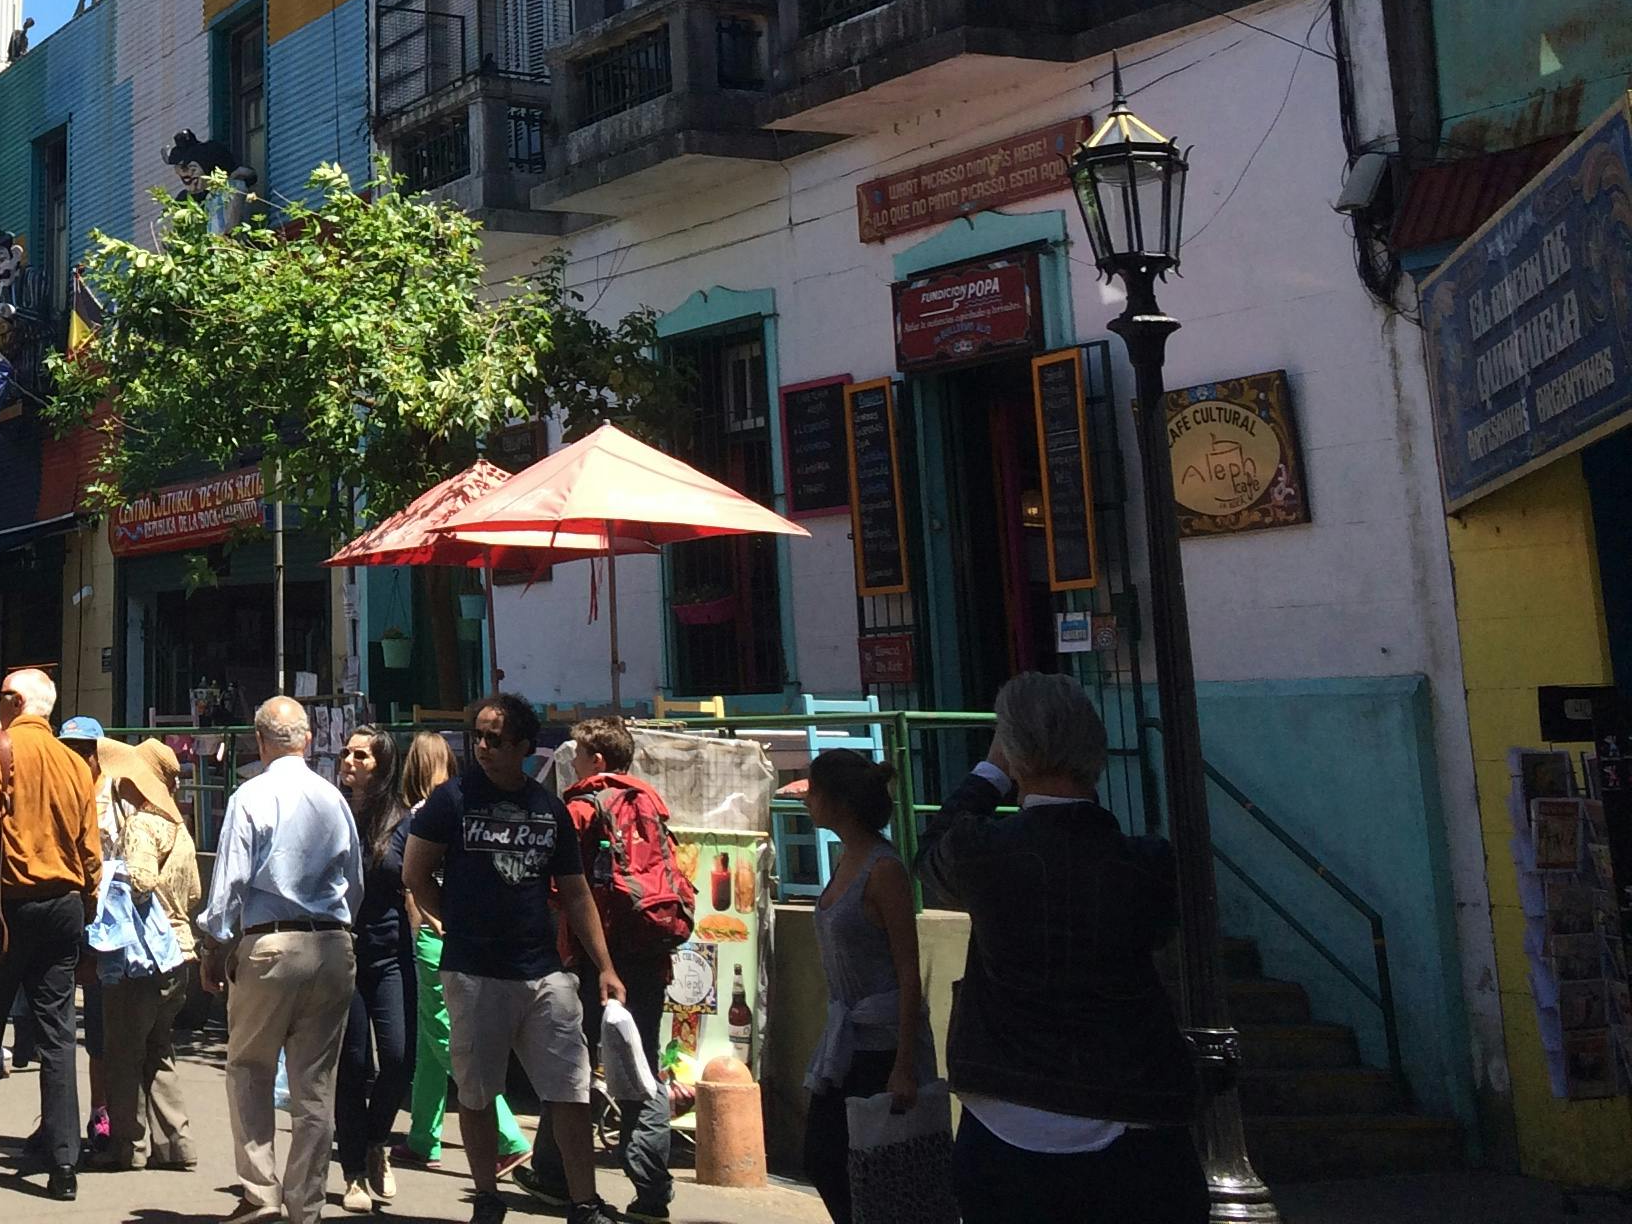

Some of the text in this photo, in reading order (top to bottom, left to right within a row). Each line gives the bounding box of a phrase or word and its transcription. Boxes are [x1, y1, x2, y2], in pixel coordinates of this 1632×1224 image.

[920, 164, 966, 191] PICASSO
[889, 203, 911, 226] QUE
[911, 198, 927, 217] NO
[920, 276, 1000, 304] FUNDICION POPA
[1467, 289, 1492, 342] EL
[1542, 220, 1573, 286] DE
[1193, 406, 1256, 437] CULTURAL
[467, 820, 555, 848] Hard Rock
